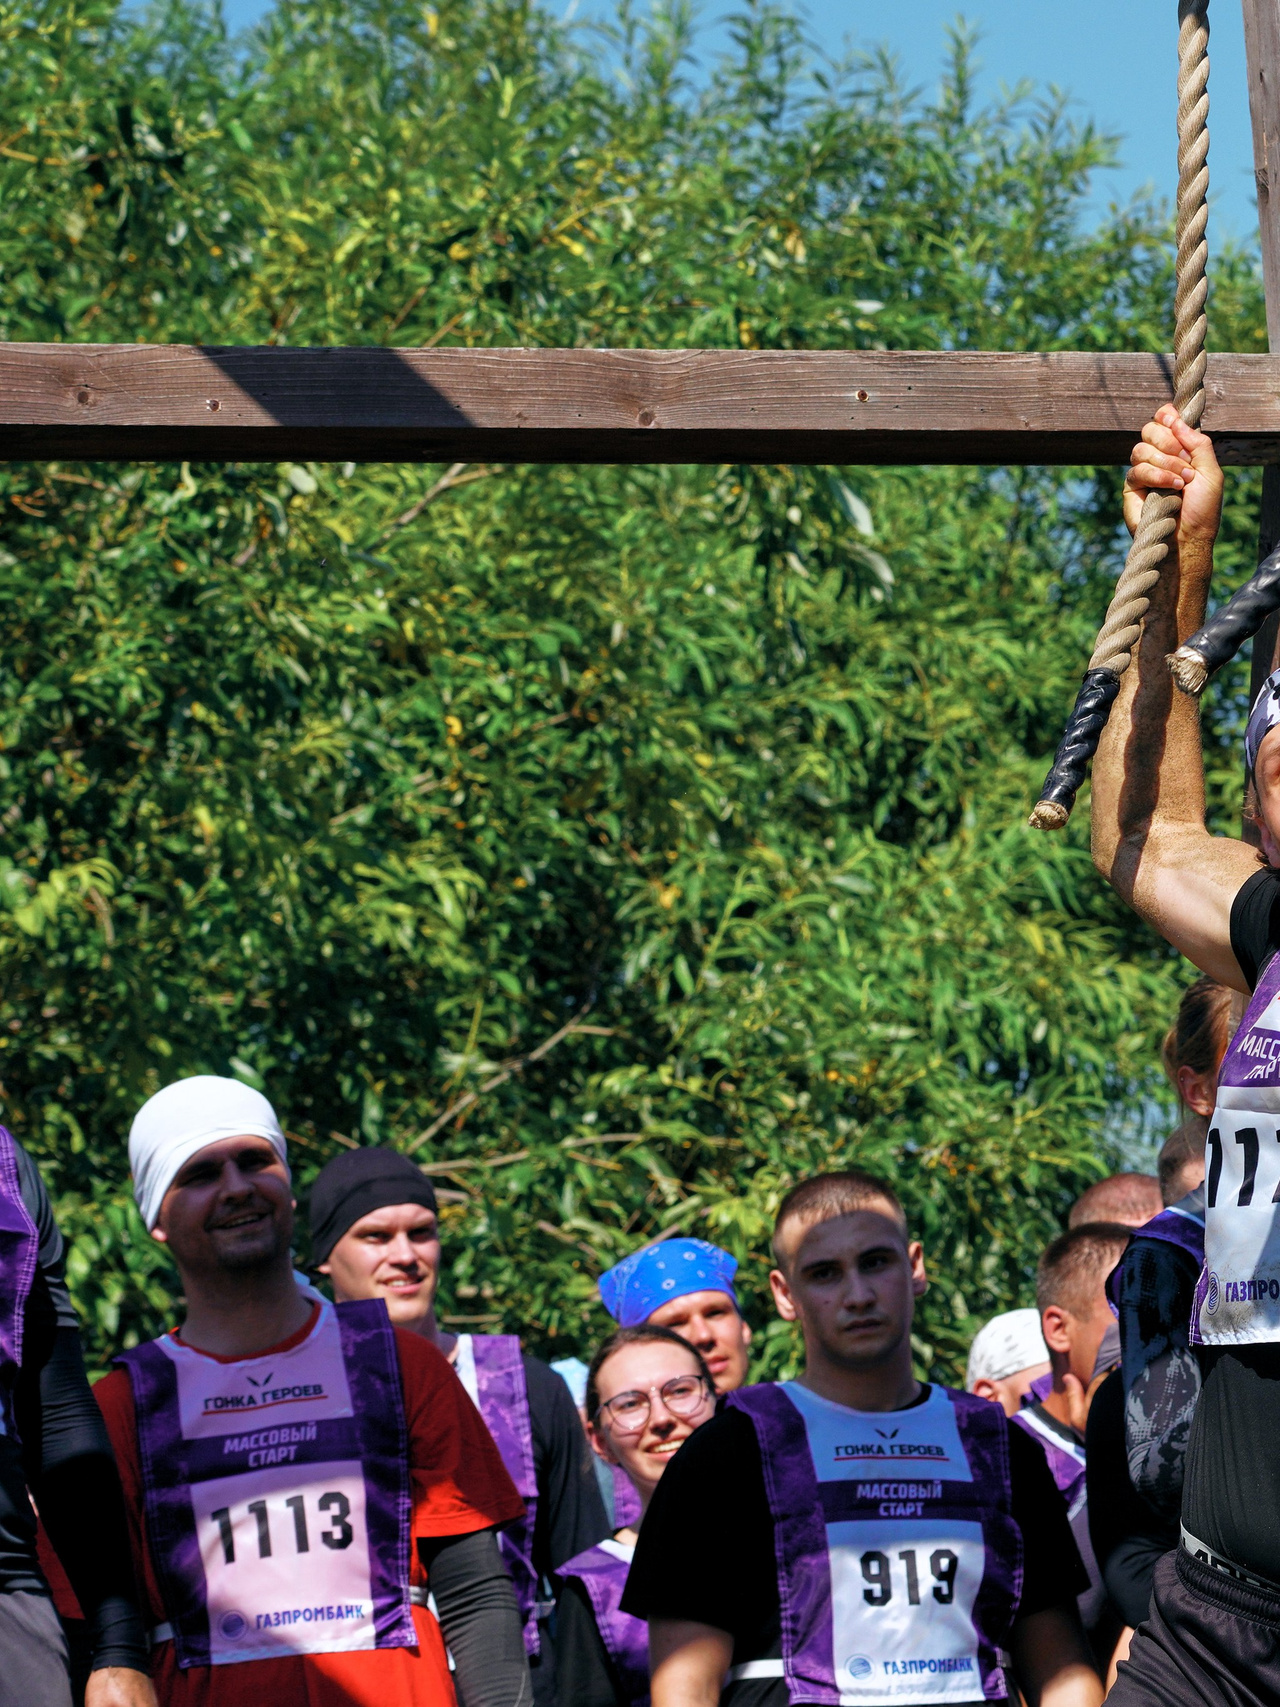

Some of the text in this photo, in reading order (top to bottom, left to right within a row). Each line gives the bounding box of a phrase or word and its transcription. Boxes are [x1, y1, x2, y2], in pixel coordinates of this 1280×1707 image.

[204, 1384, 323, 1410] ГОНКА ГЕРОЕВ
[223, 1420, 318, 1455] МАССОВЫЙ
[835, 1444, 945, 1456] ГОНКА ГЕРОЕВ
[248, 1444, 298, 1468] СТАРТ
[856, 1480, 942, 1499] МАССОВЫЙ
[879, 1502, 925, 1516] СТАРТ
[211, 1491, 354, 1565] 1113
[860, 1549, 959, 1607] 919
[256, 1604, 365, 1630] ГАЗПРОМБАНК
[883, 1657, 974, 1676] ГАЗПРОМБАНК
